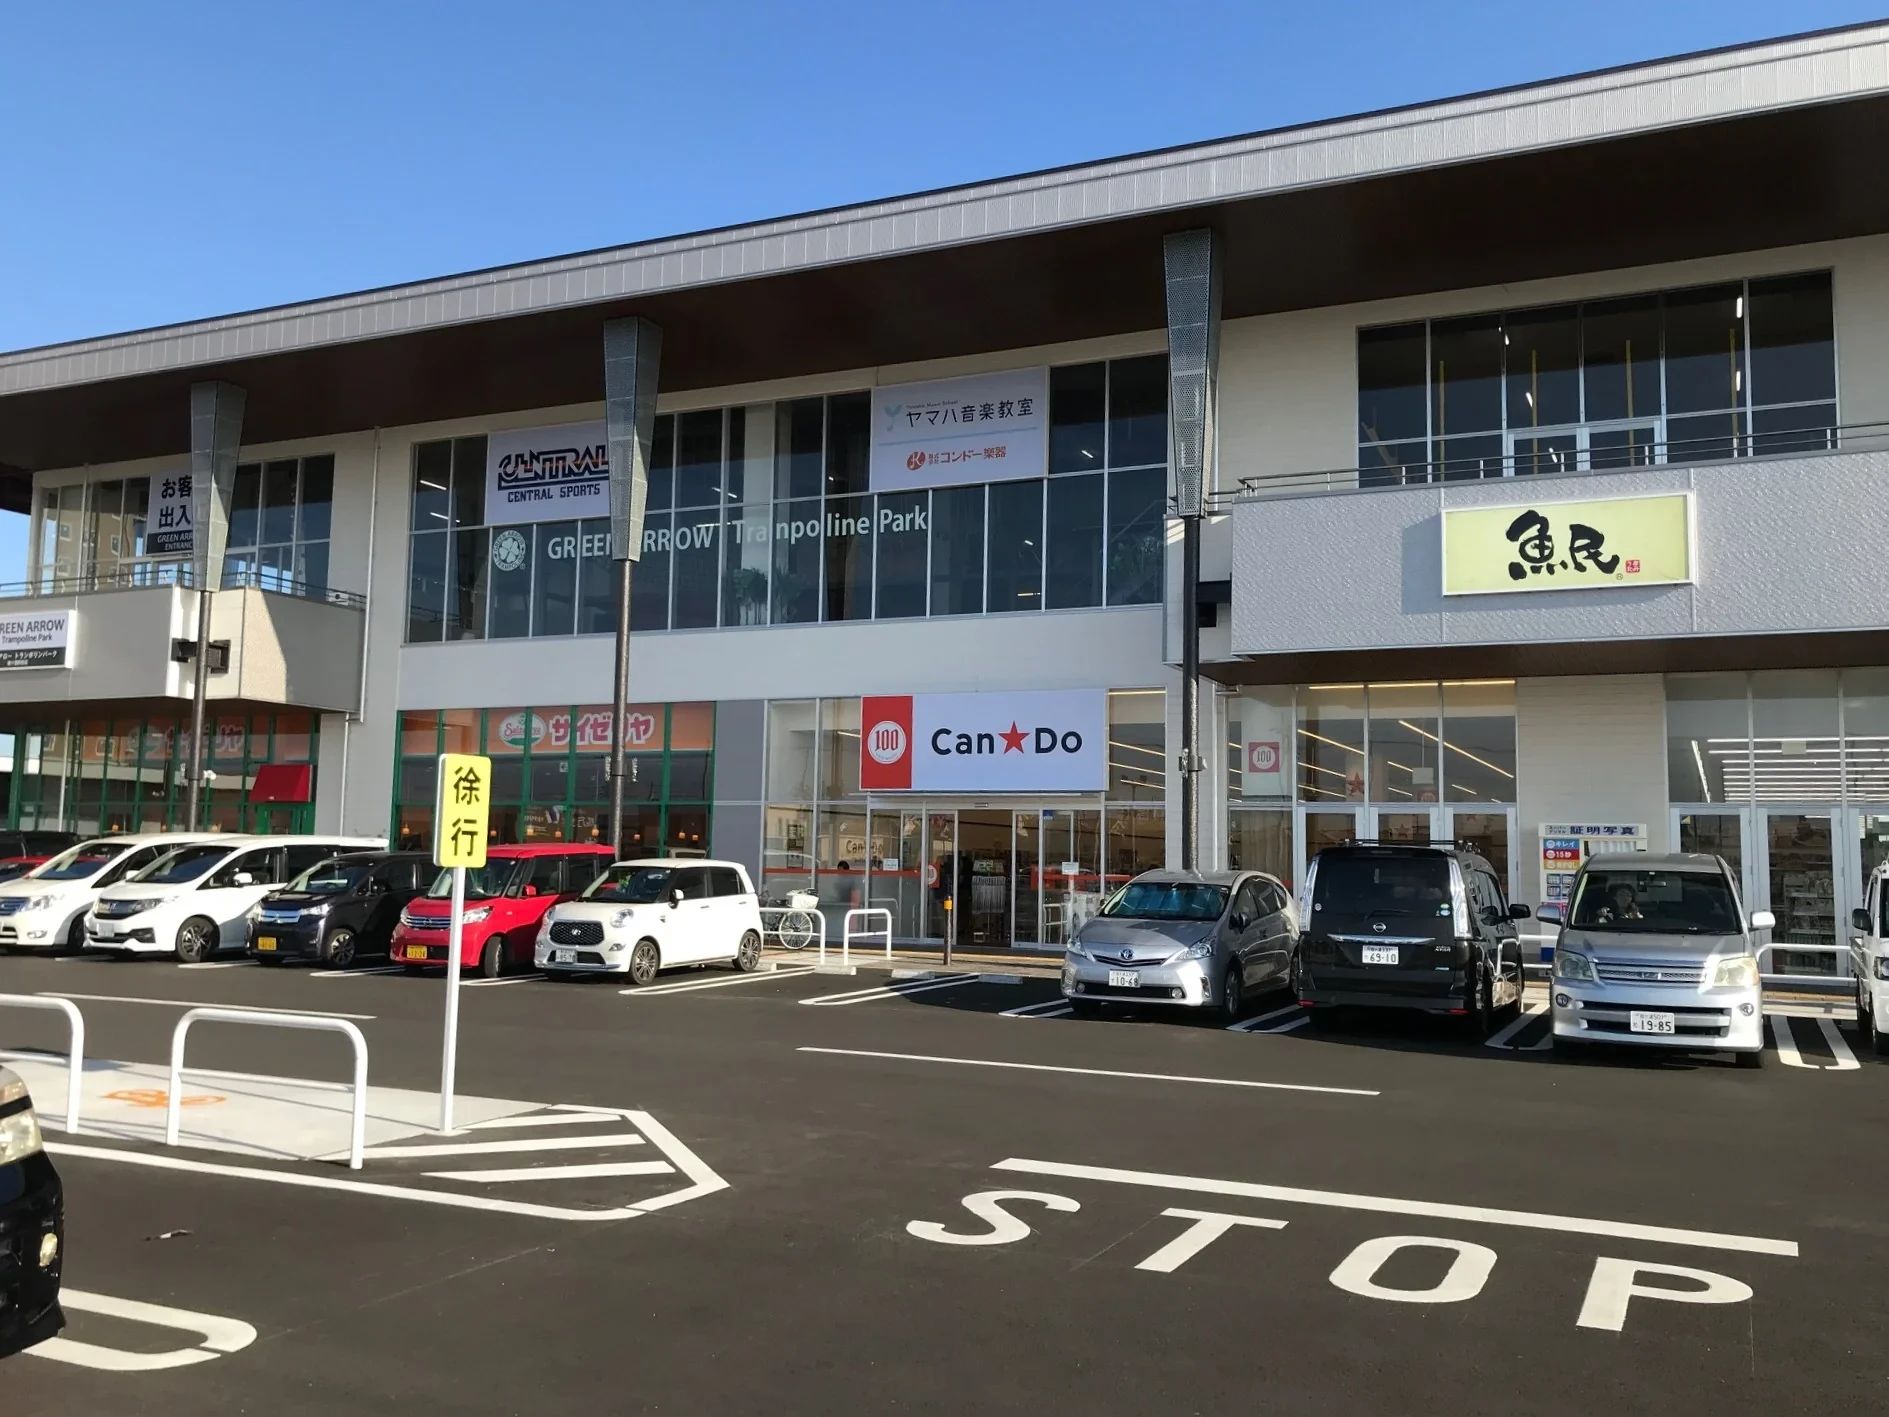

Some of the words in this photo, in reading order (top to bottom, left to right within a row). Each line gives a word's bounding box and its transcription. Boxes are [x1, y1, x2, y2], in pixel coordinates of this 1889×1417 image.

[906, 397, 1033, 428] ヤマハ音楽教室
[508, 488, 553, 503] CENTRAL
[560, 483, 600, 498] SPORTS
[641, 526, 714, 553] RROW
[879, 504, 927, 536] Park
[1505, 509, 1621, 581] 魚民
[26, 618, 65, 633] ARROW
[37, 632, 53, 642] Park
[874, 728, 899, 752] 100
[931, 727, 995, 756] Can
[1034, 727, 1083, 754] Do
[1256, 750, 1271, 763] 100
[451, 766, 481, 857] 徐行
[1569, 825, 1635, 836] 証明写真
[905, 1189, 1754, 1331] STOP
